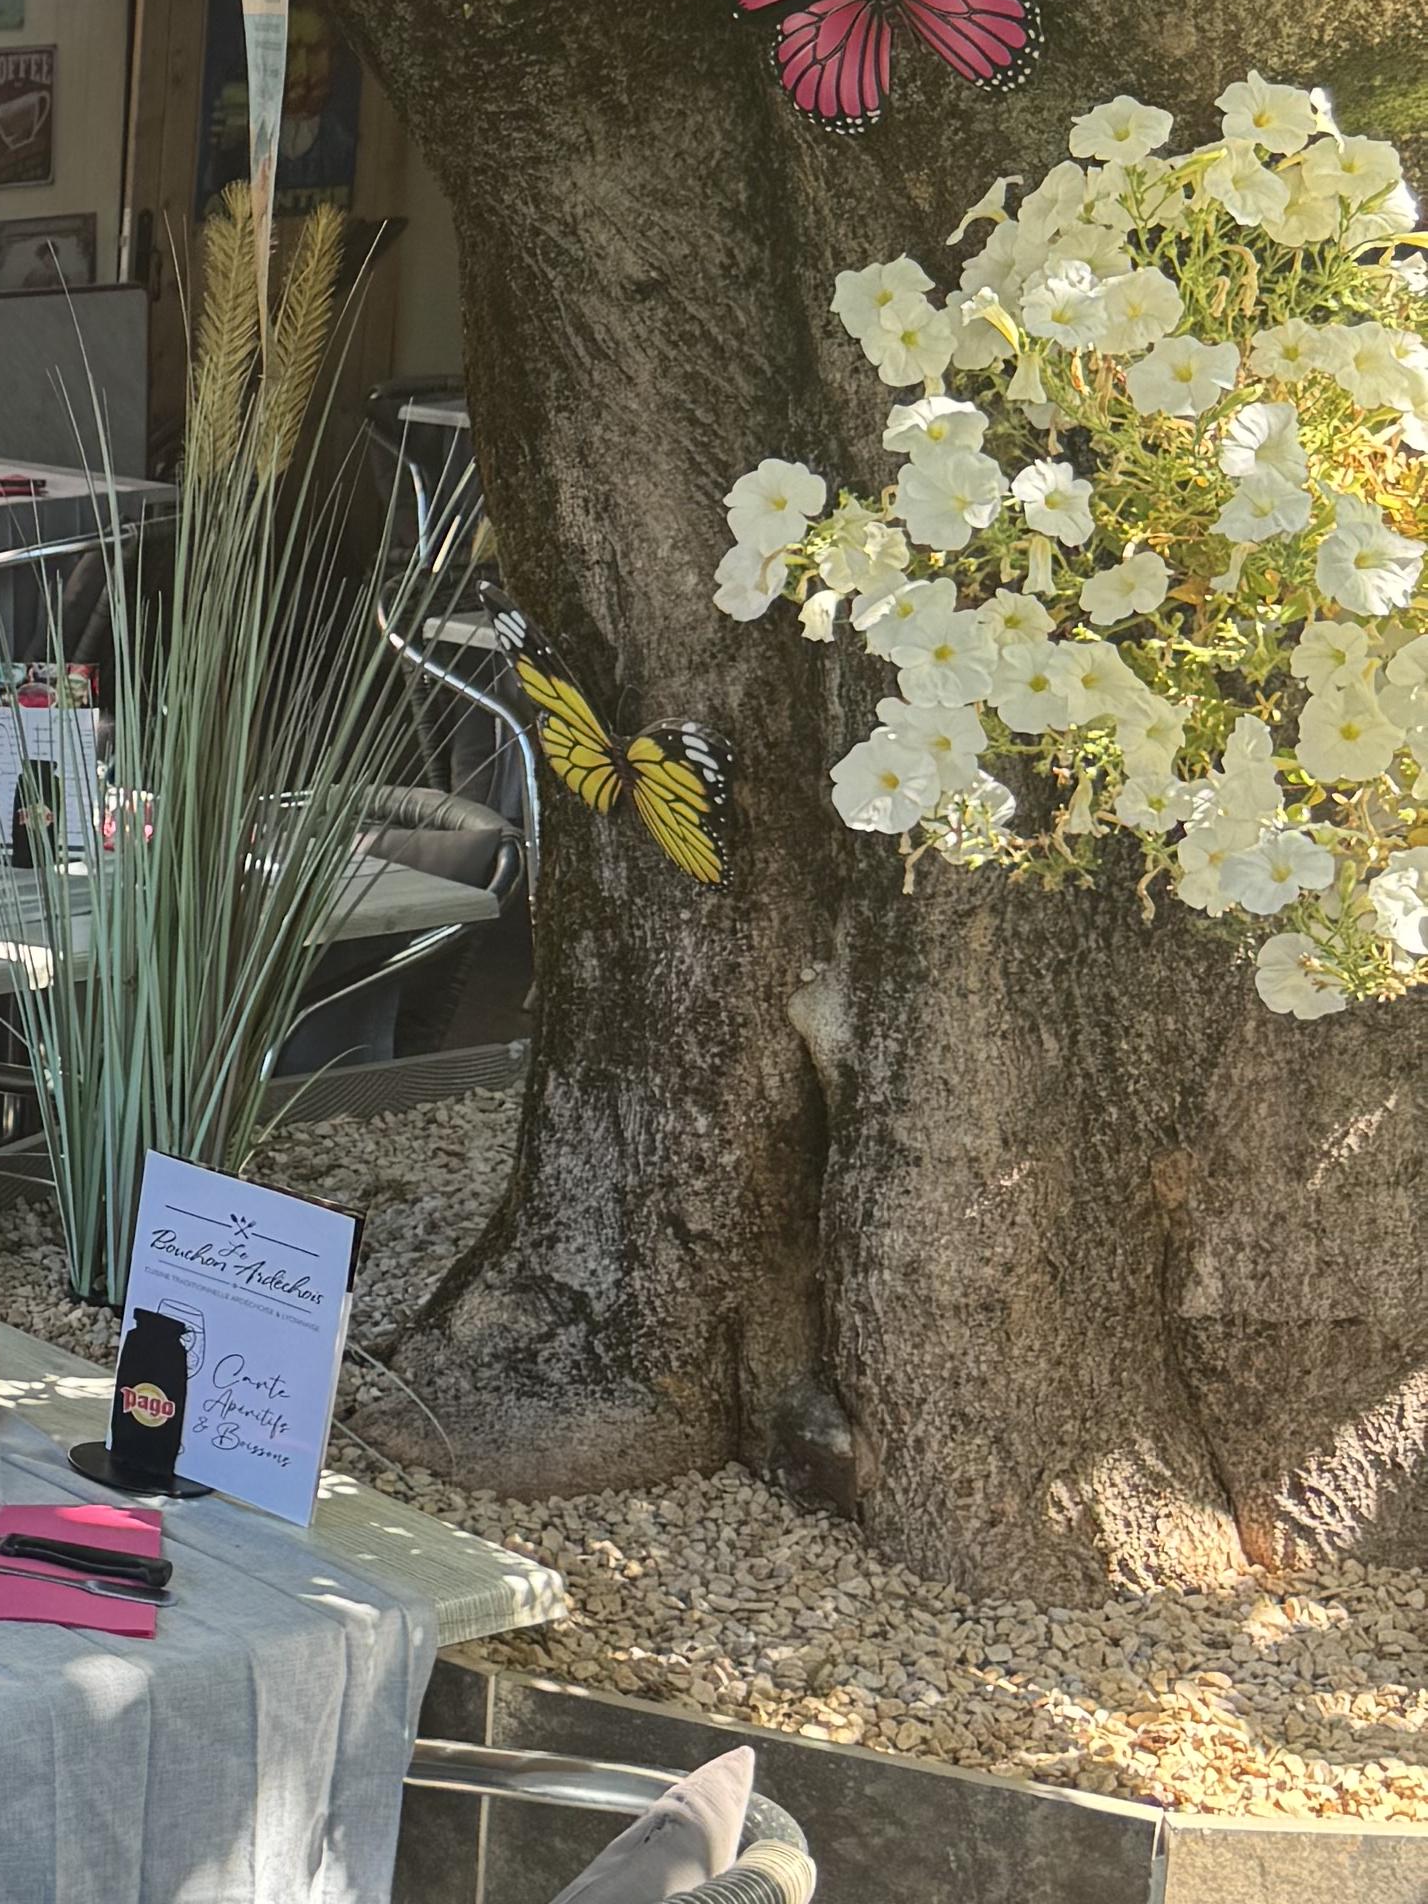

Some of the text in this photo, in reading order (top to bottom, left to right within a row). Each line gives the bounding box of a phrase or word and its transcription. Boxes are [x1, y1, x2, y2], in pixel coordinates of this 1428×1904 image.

[150, 1229, 227, 1272] Bouchon
[213, 1354, 291, 1400] Carte
[120, 1386, 176, 1418] pago
[192, 1416, 291, 1468] & Boissons
